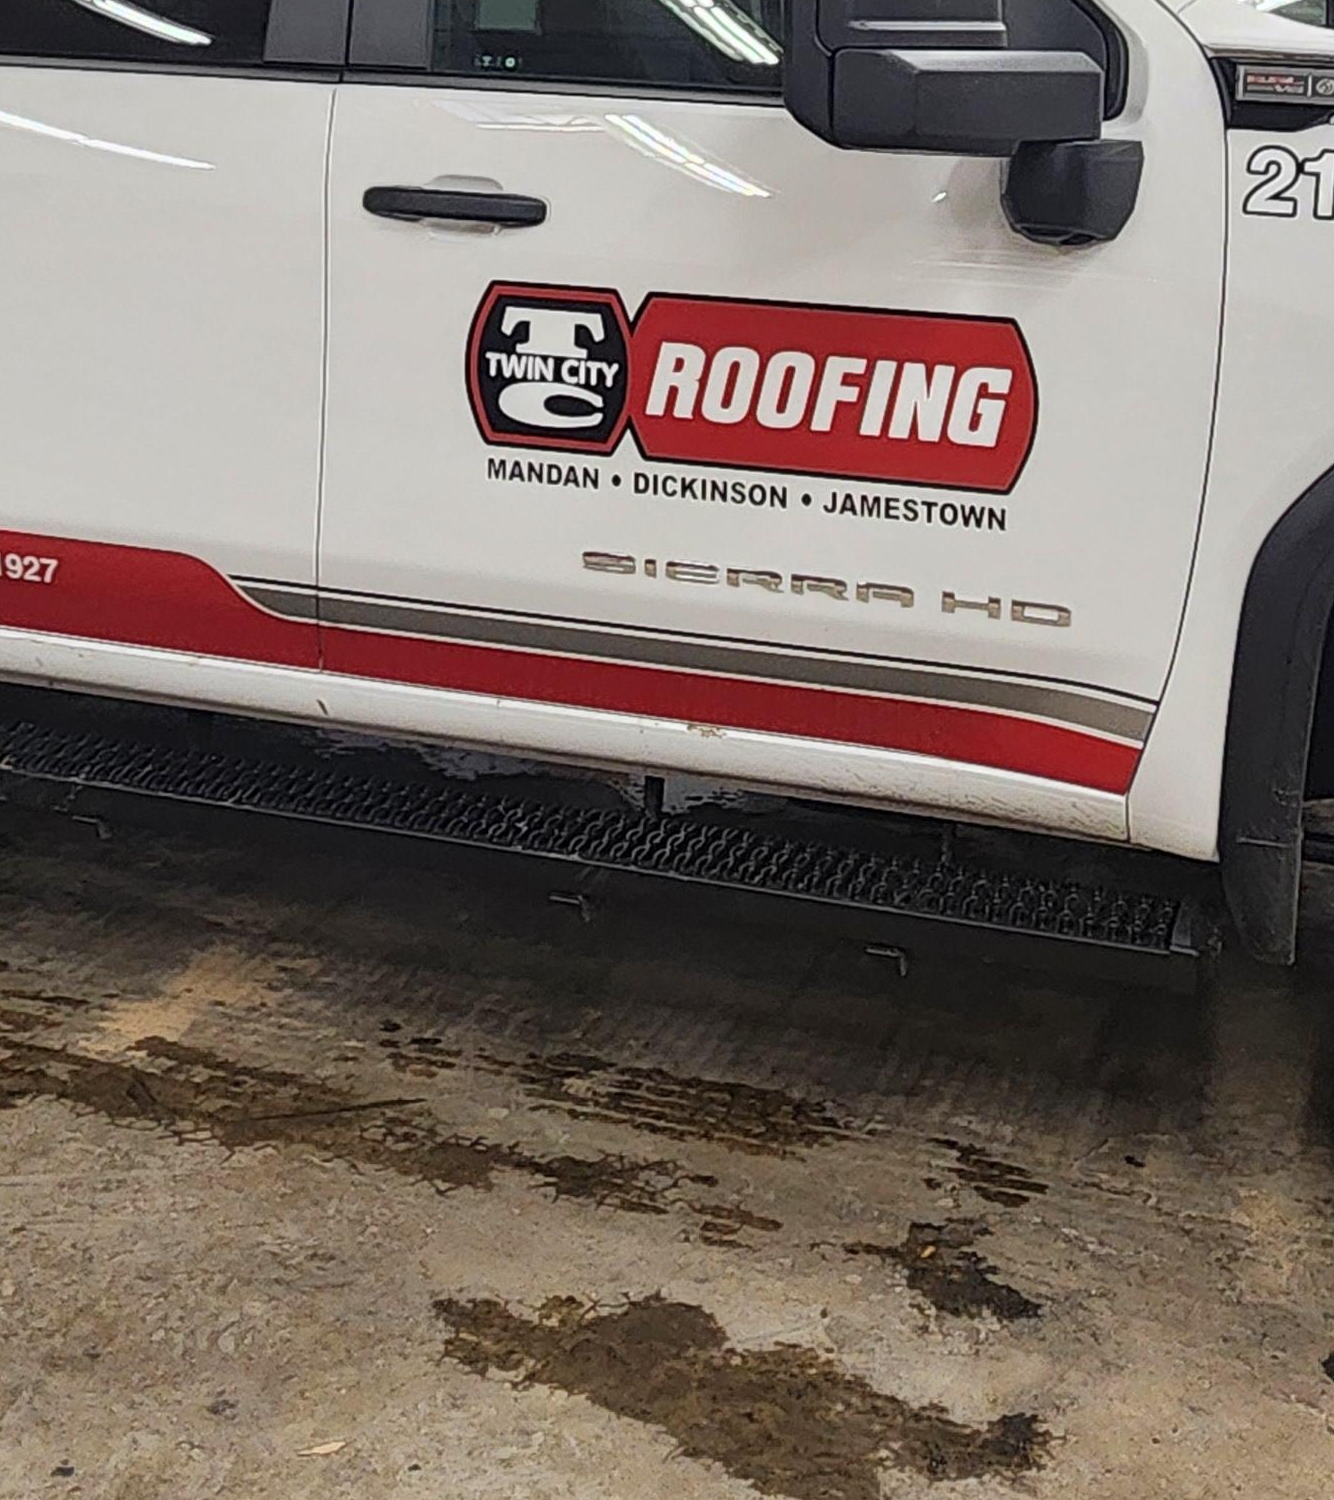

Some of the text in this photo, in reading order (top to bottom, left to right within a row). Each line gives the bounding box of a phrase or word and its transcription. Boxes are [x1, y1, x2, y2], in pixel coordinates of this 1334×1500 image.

[485, 352, 619, 388] TWIN CITY
[645, 341, 1013, 448] ROOFING
[487, 457, 1006, 531] MANDAN DICKINSON JAMESTOWN
[582, 550, 1072, 627] SIERRA HD
